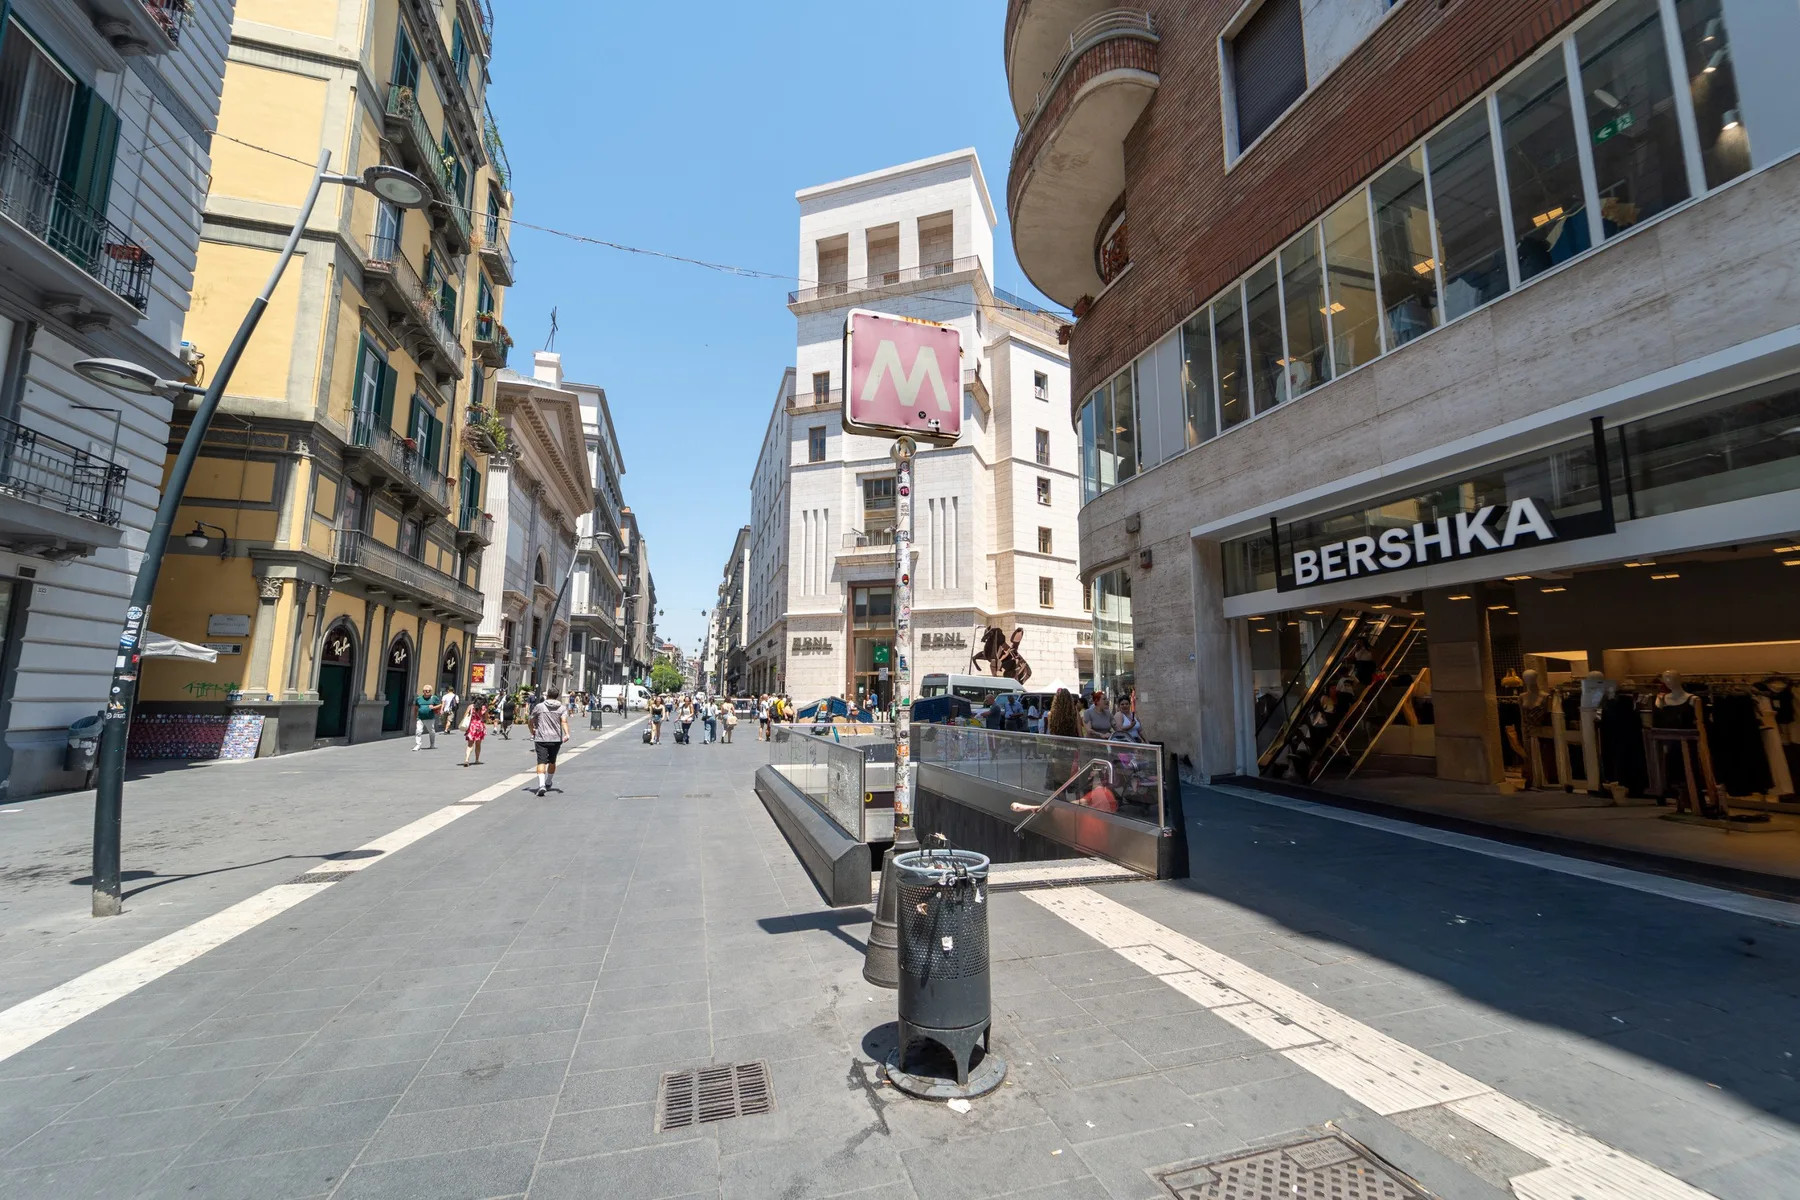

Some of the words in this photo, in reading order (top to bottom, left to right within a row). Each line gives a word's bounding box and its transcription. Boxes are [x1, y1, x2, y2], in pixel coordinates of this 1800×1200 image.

[861, 340, 952, 412] M
[1294, 497, 1554, 586] BERSHKA
[803, 637, 831, 647] BNL
[933, 632, 965, 643] BNL
